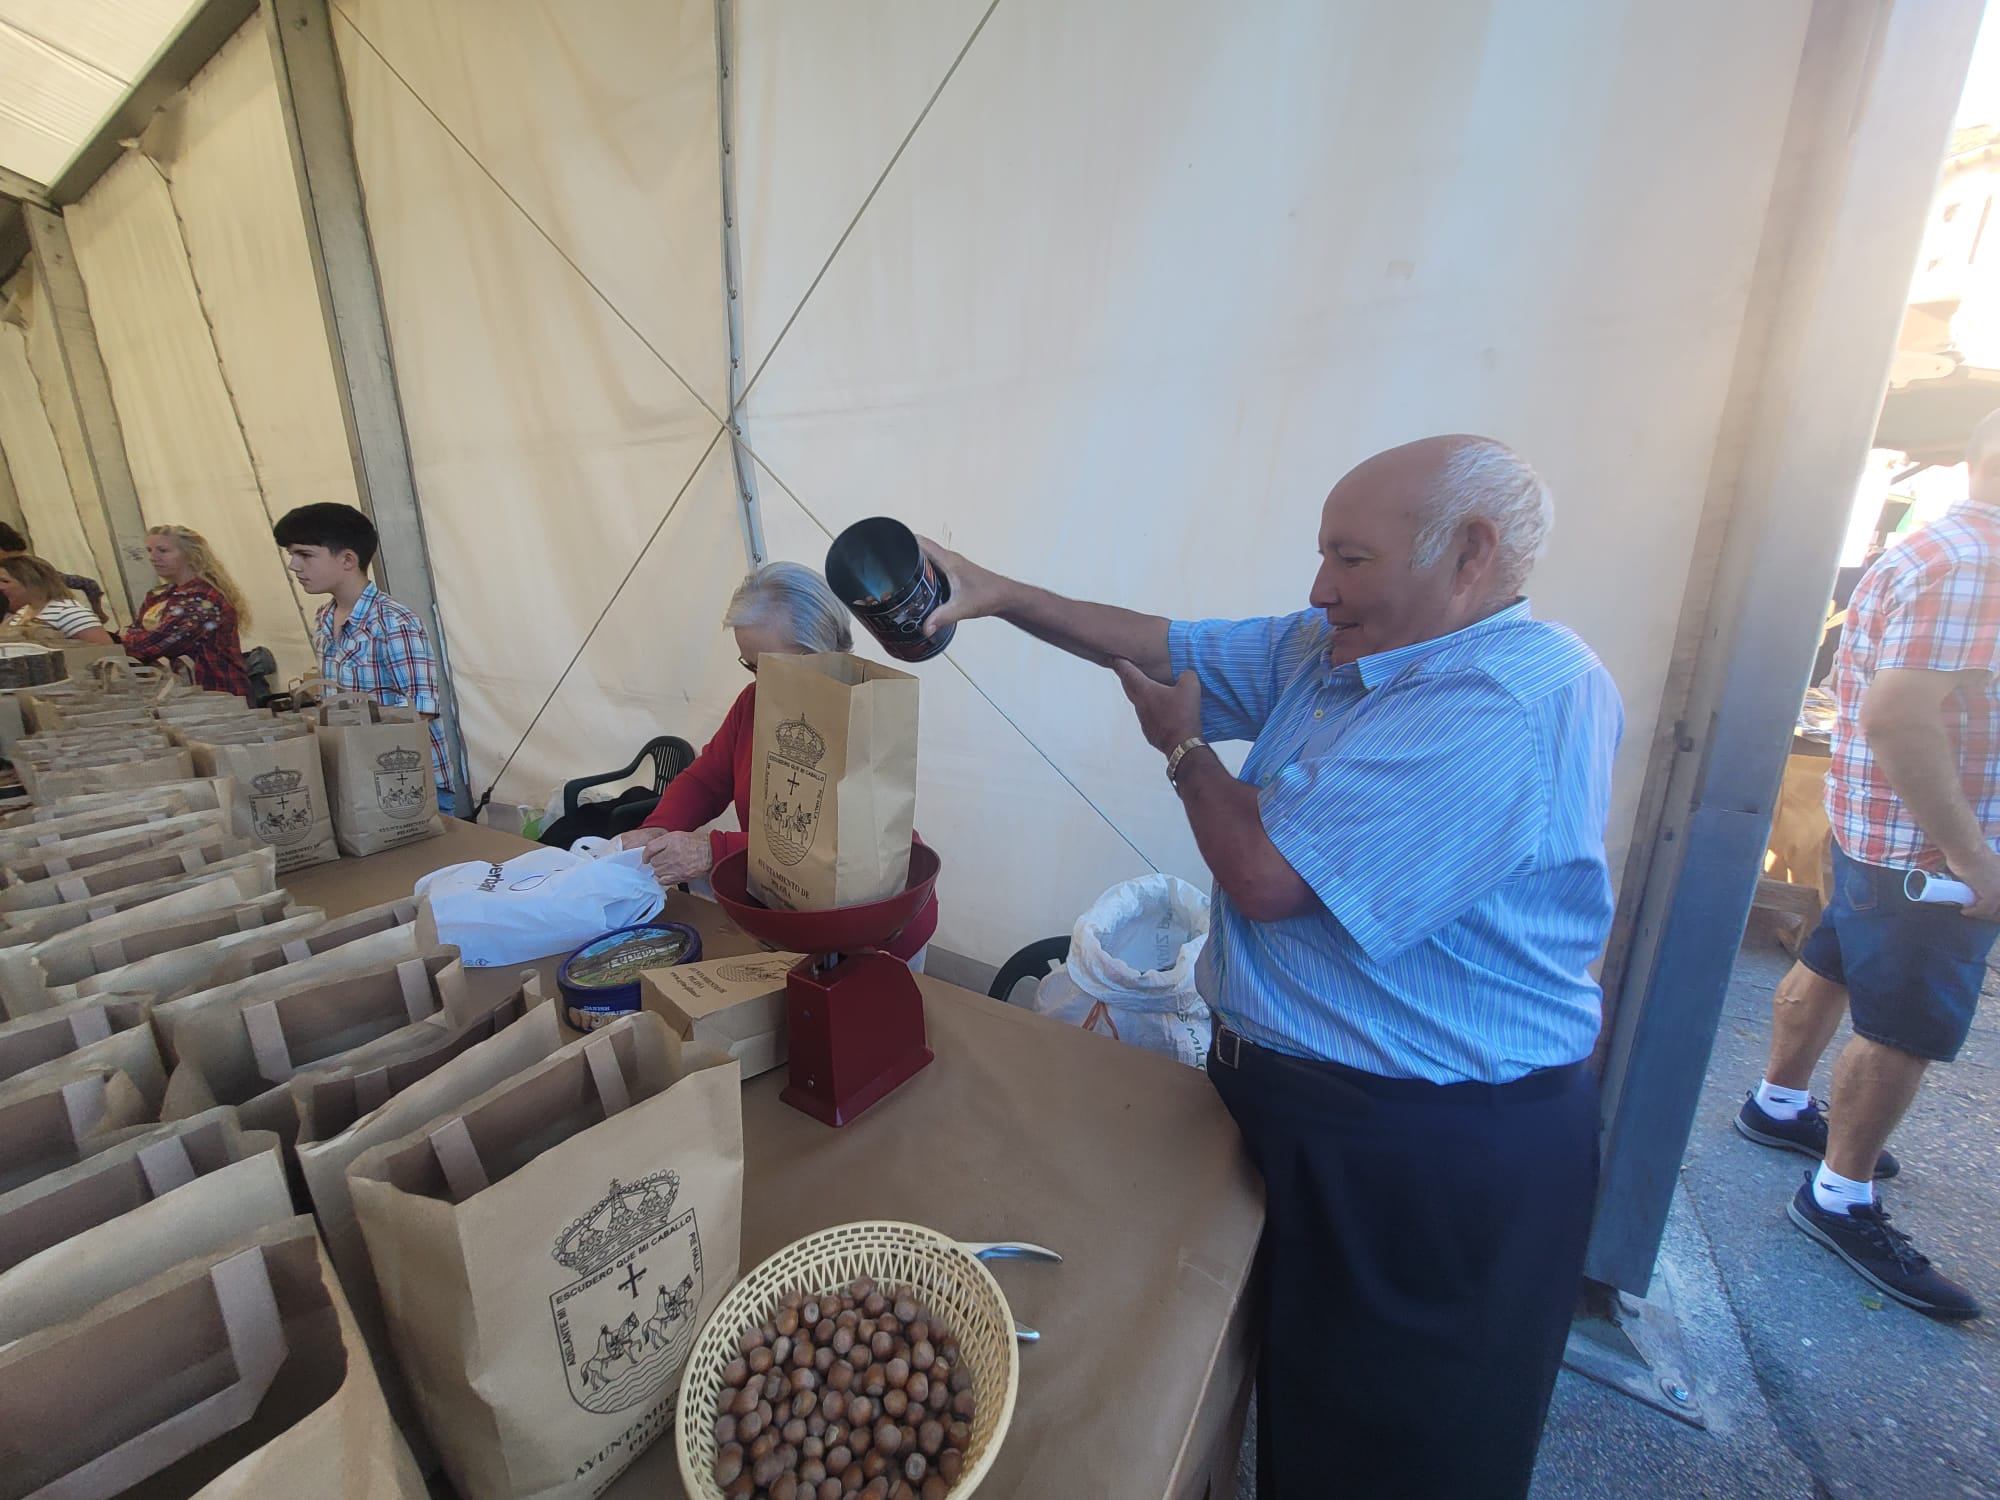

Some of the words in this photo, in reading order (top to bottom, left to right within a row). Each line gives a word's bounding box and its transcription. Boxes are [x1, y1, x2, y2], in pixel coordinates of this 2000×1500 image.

[556, 1267, 614, 1305] ESCUDERO
[616, 1250, 637, 1270] QUE
[638, 1240, 650, 1257] MI
[651, 1215, 693, 1246] CABALLO
[689, 1247, 701, 1275] HALLA
[559, 1320, 577, 1367] ADELANTE
